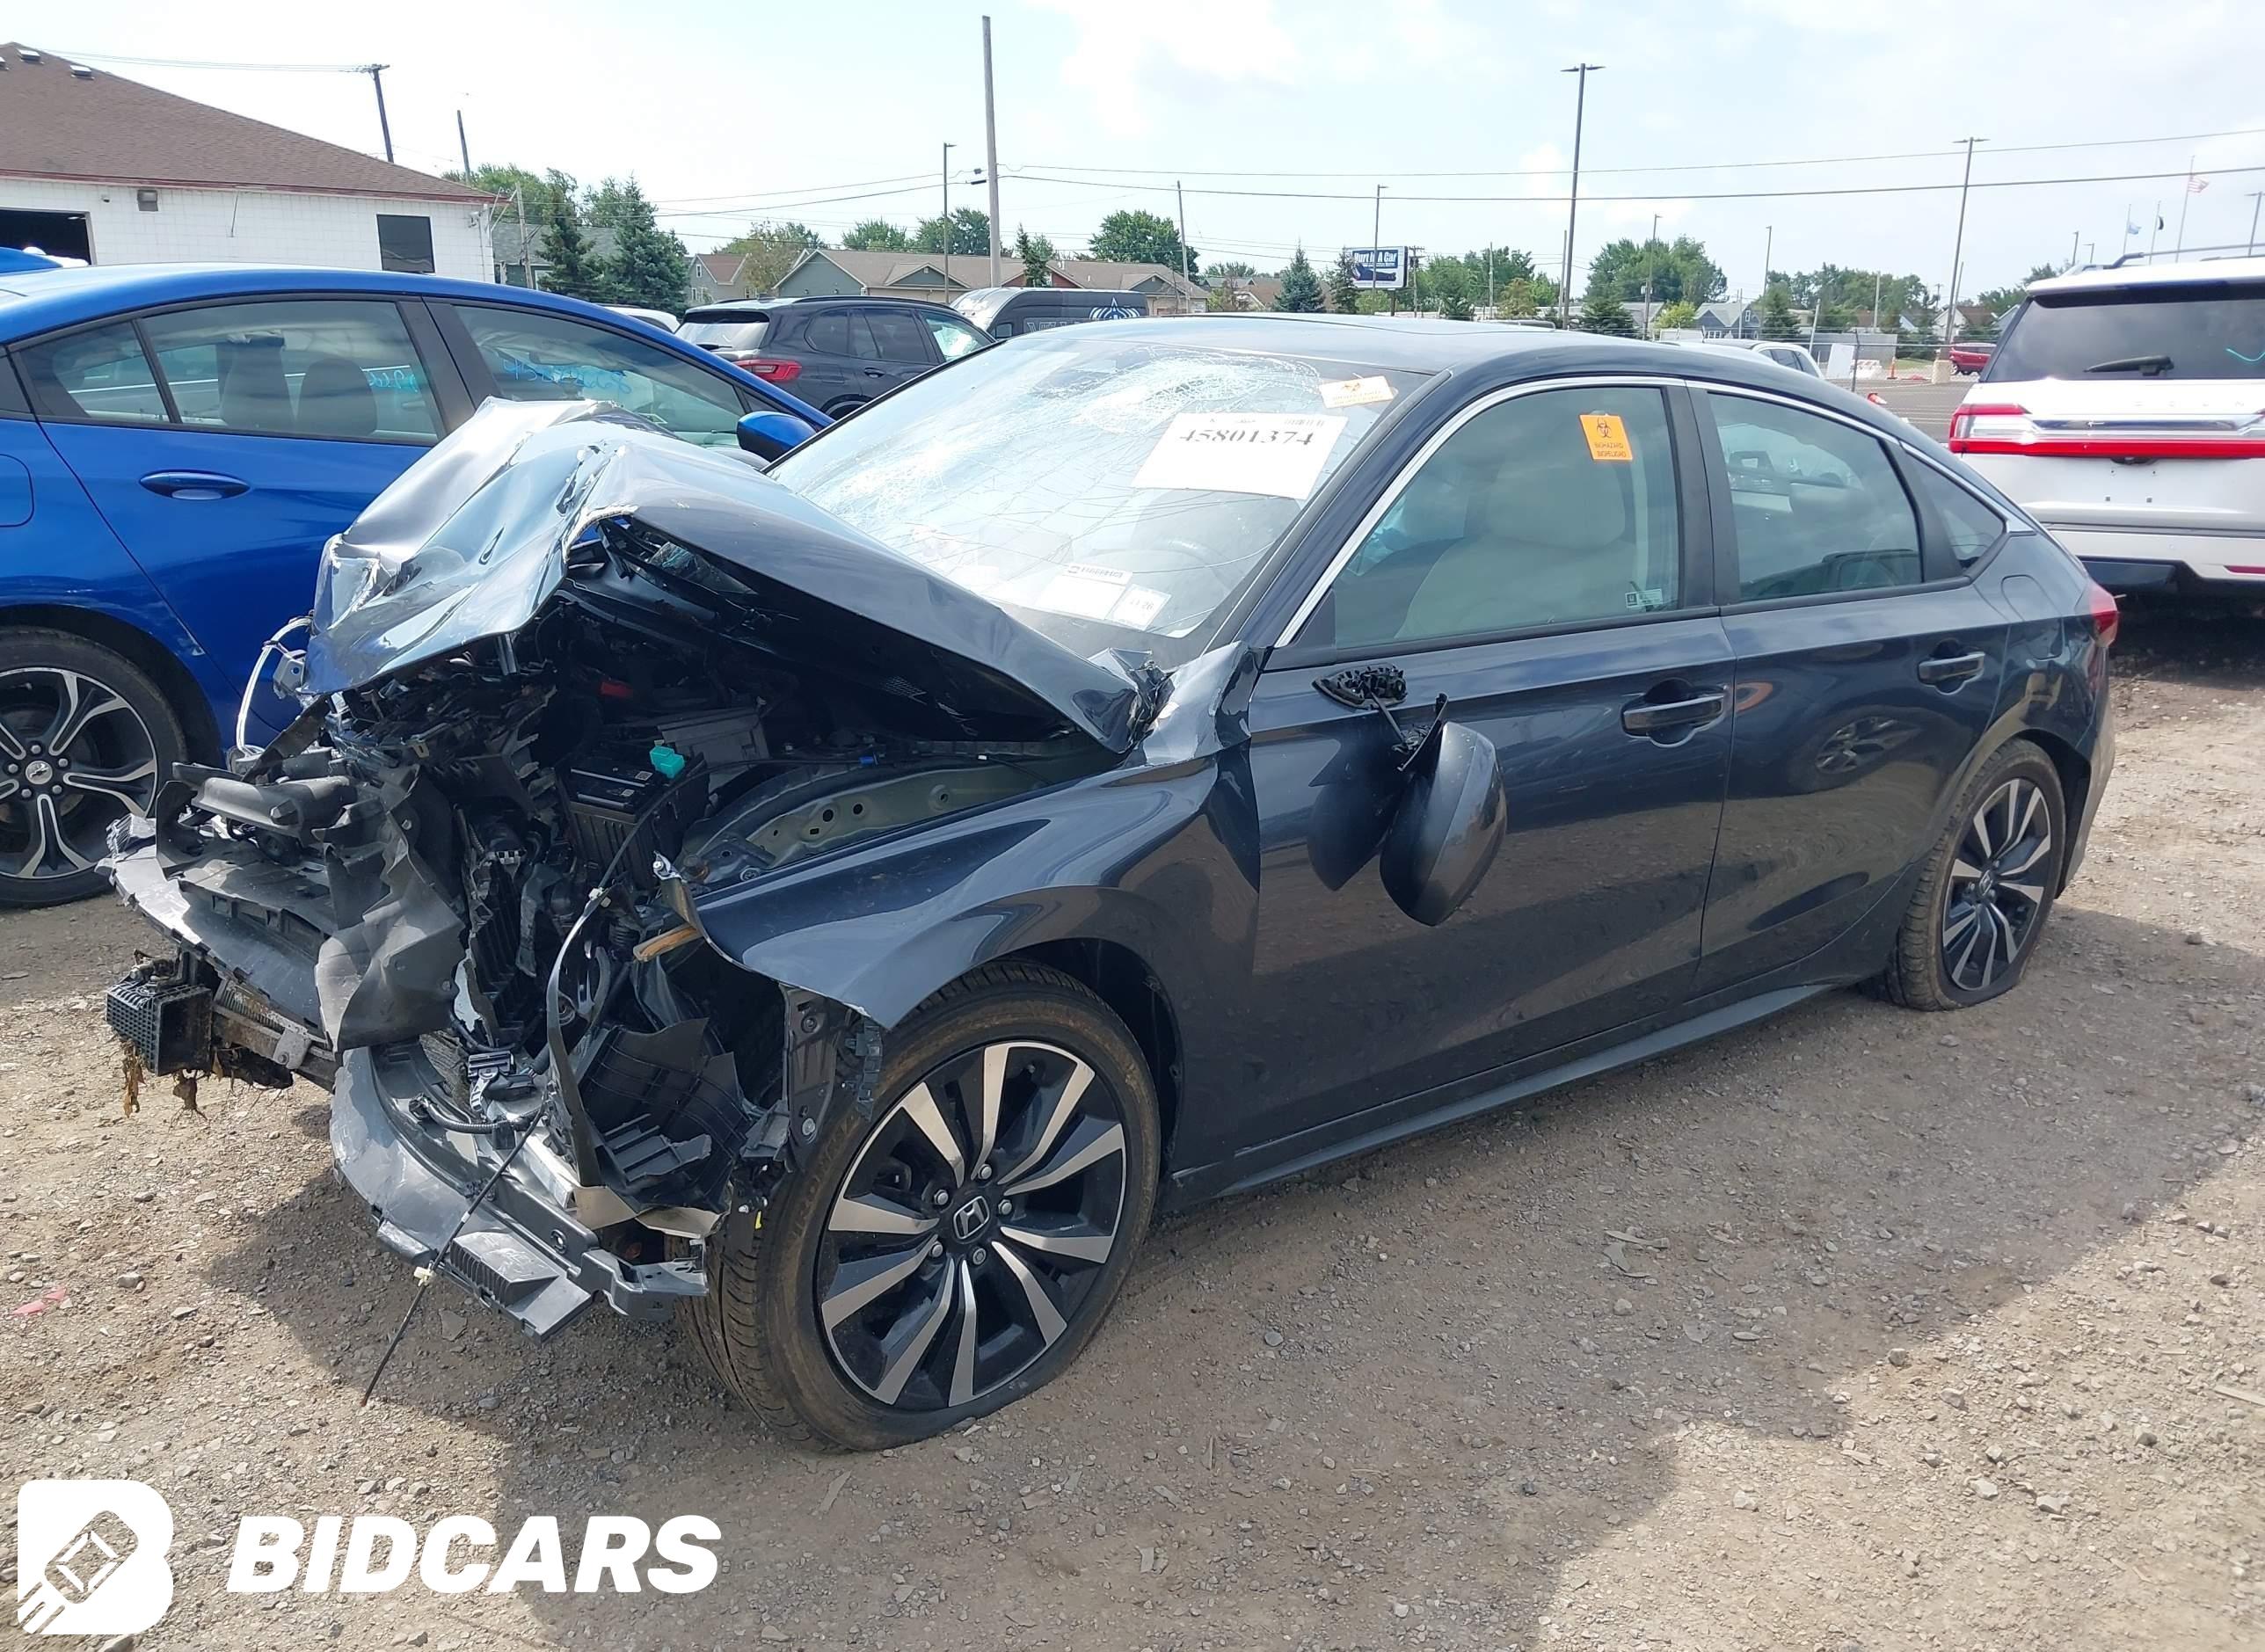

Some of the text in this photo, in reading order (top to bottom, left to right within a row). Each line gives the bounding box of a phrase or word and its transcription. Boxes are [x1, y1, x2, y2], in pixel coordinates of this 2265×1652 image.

[1378, 251, 1383, 263] A
[1384, 251, 1397, 263] Car
[1179, 429, 1314, 445] 45801374
